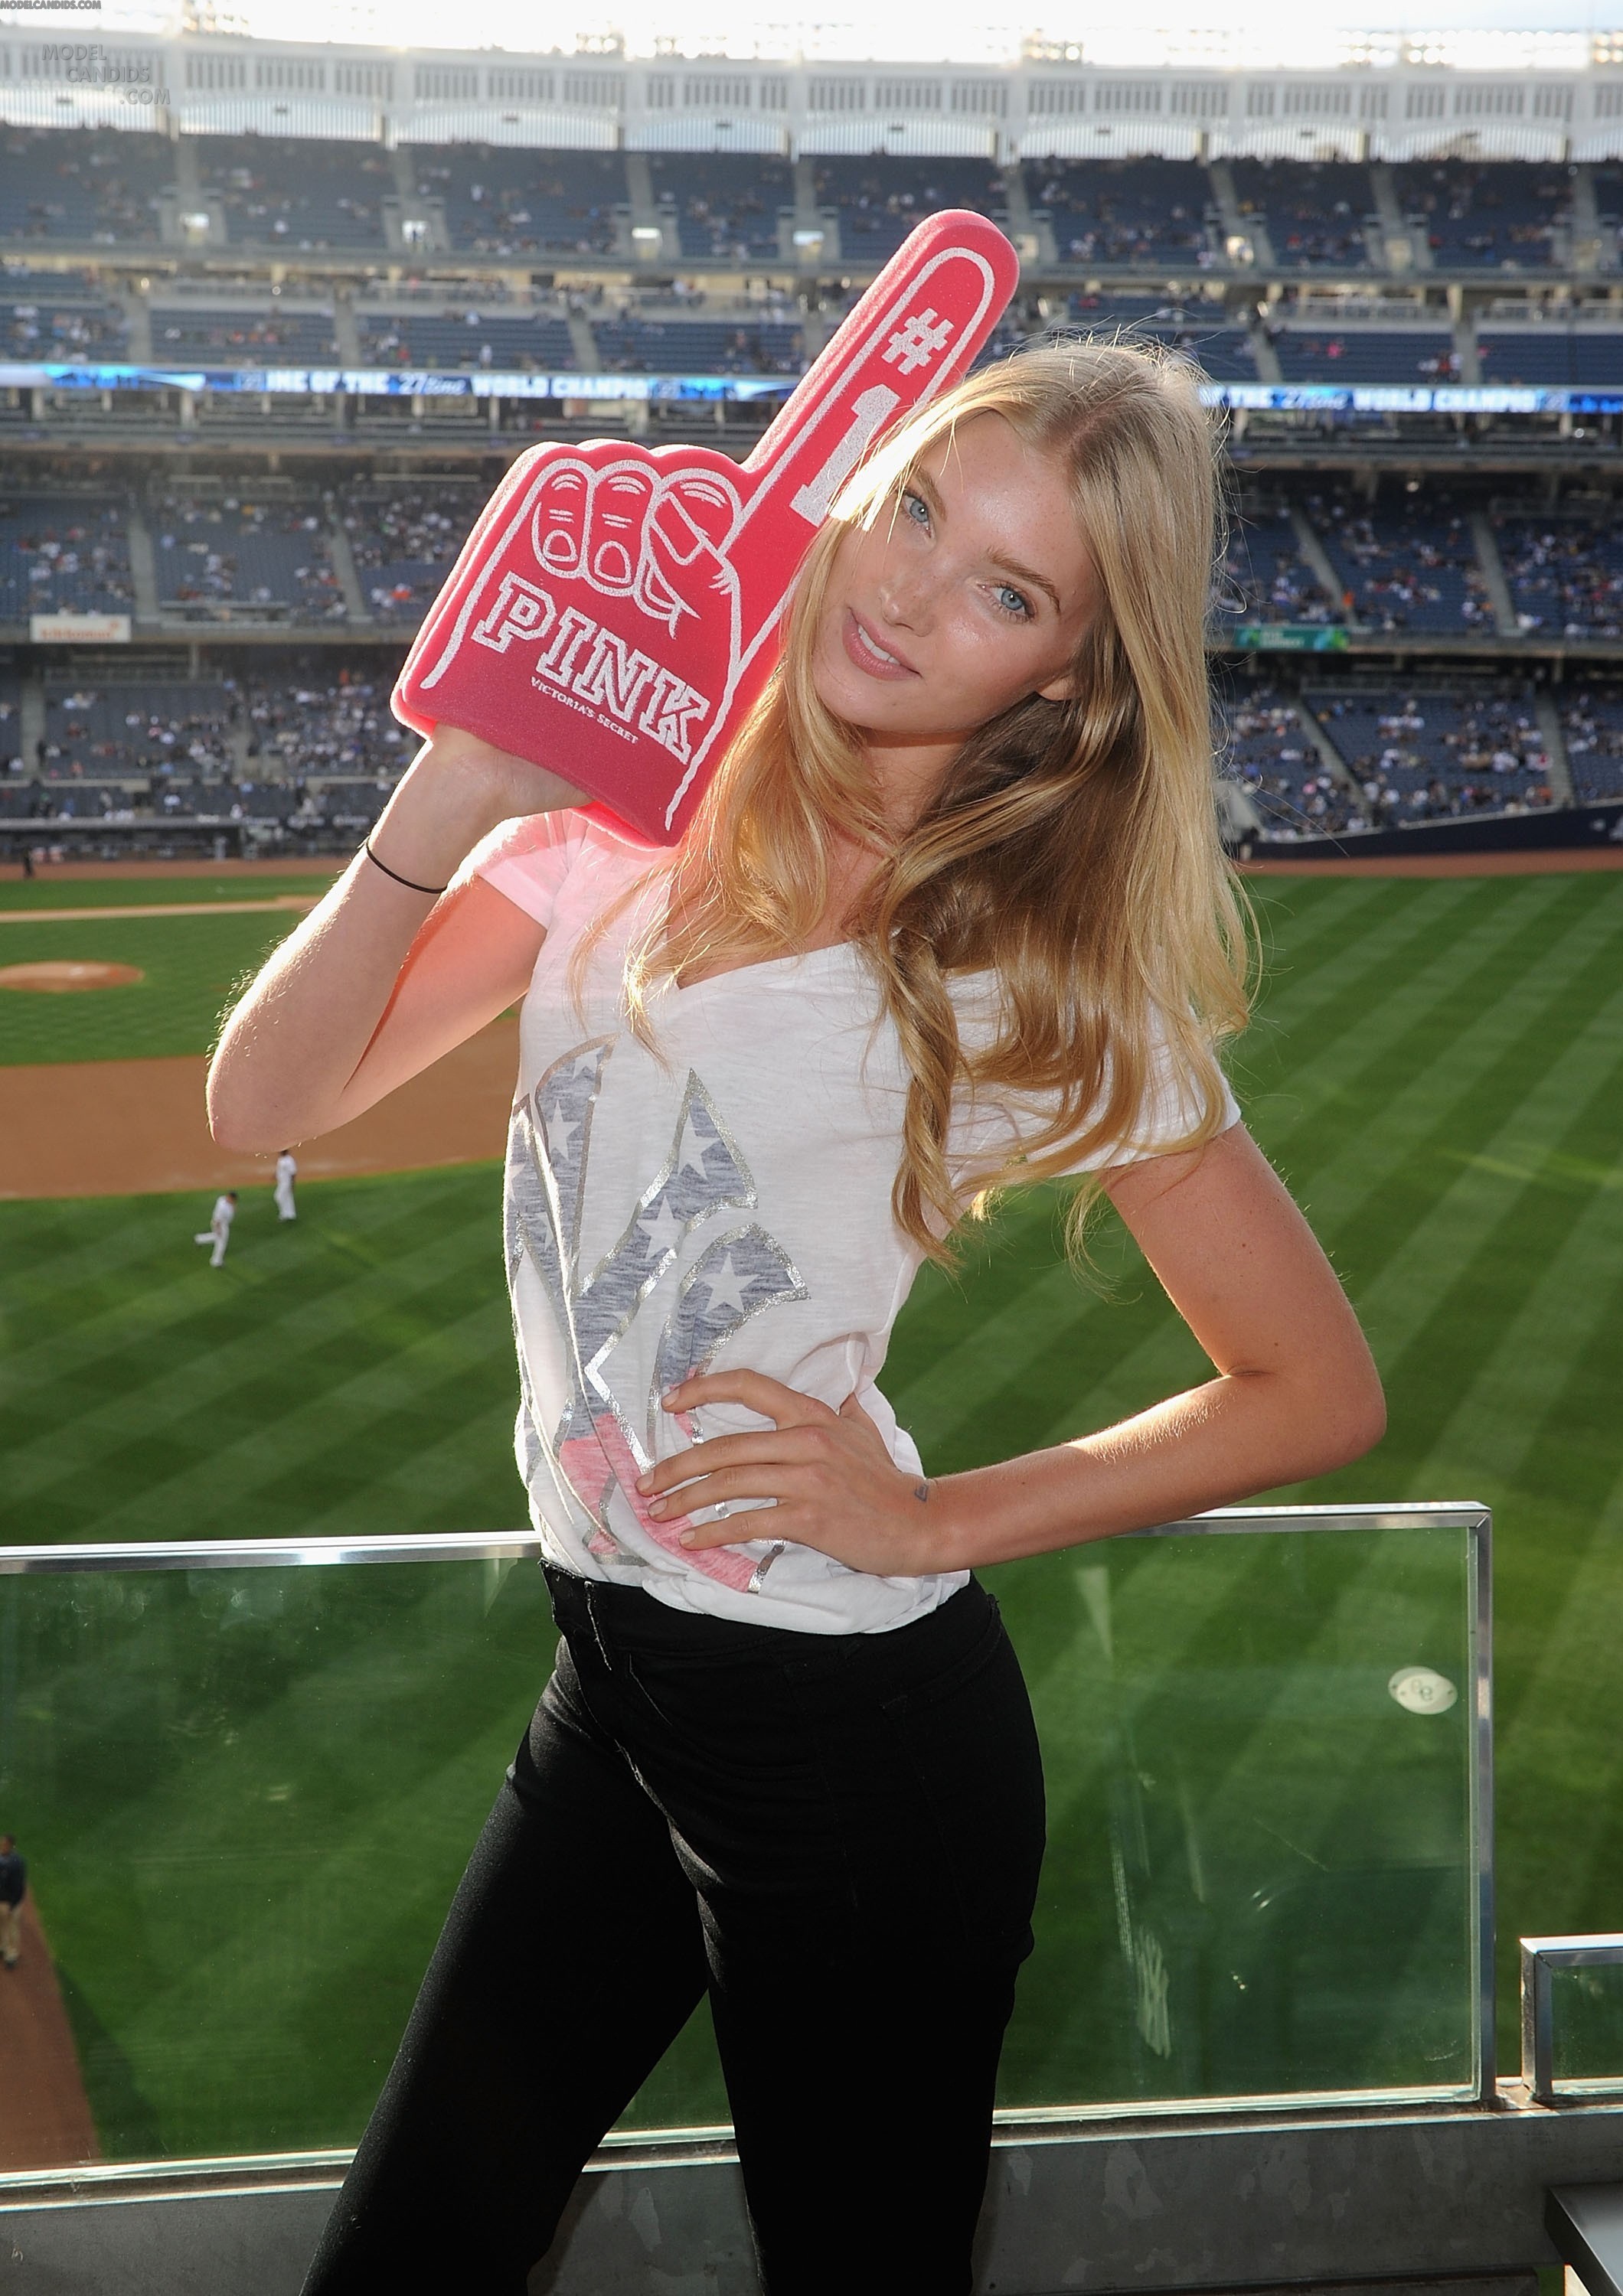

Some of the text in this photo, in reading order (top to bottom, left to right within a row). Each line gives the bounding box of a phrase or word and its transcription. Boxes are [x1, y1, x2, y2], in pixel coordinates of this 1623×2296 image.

[342, 371, 389, 393] THE
[471, 374, 548, 396] WORLD
[1354, 388, 1432, 411] WORLD
[470, 570, 710, 765] PINK
[531, 676, 638, 745] VICTORIA'S SECRET
